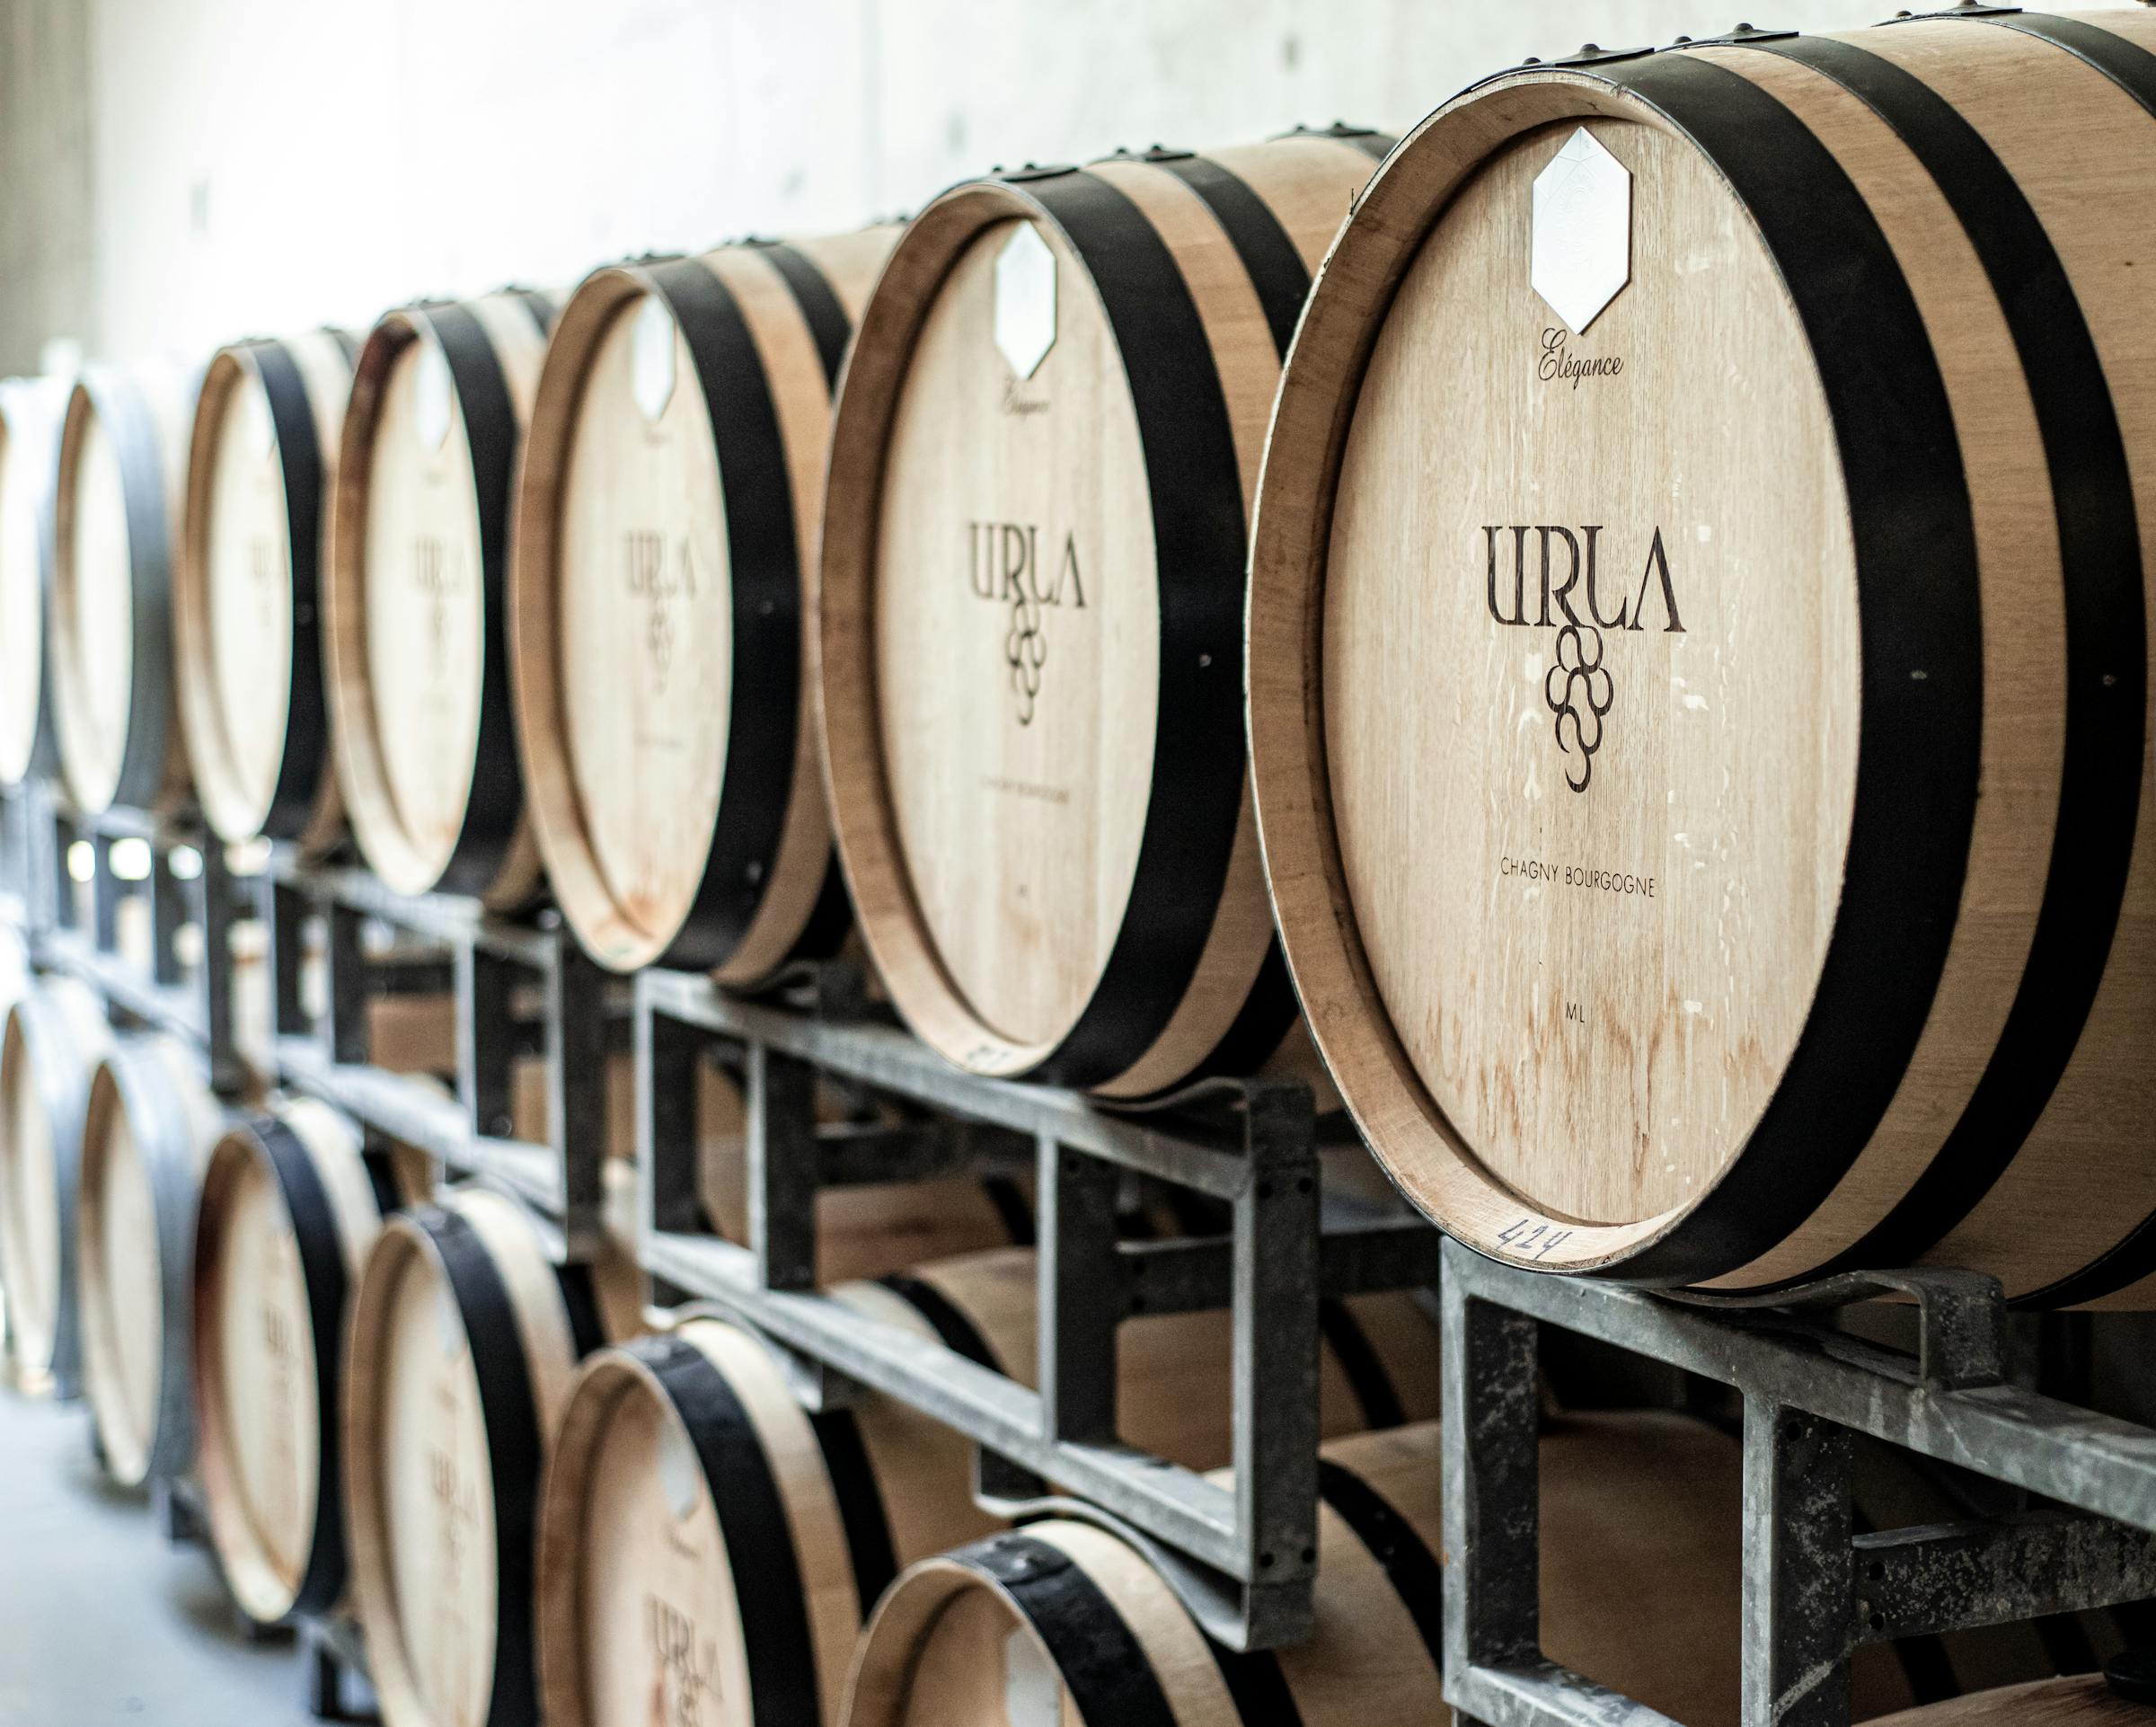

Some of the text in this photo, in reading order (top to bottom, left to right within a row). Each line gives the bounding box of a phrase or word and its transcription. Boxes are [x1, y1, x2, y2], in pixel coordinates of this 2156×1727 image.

[967, 520, 1086, 609] URLA
[1480, 525, 1687, 633] URLA
[1500, 856, 1656, 898] CHAGNY BOURGOGNE
[1566, 1001, 1586, 1023] ML
[1496, 1218, 1574, 1261] 424
